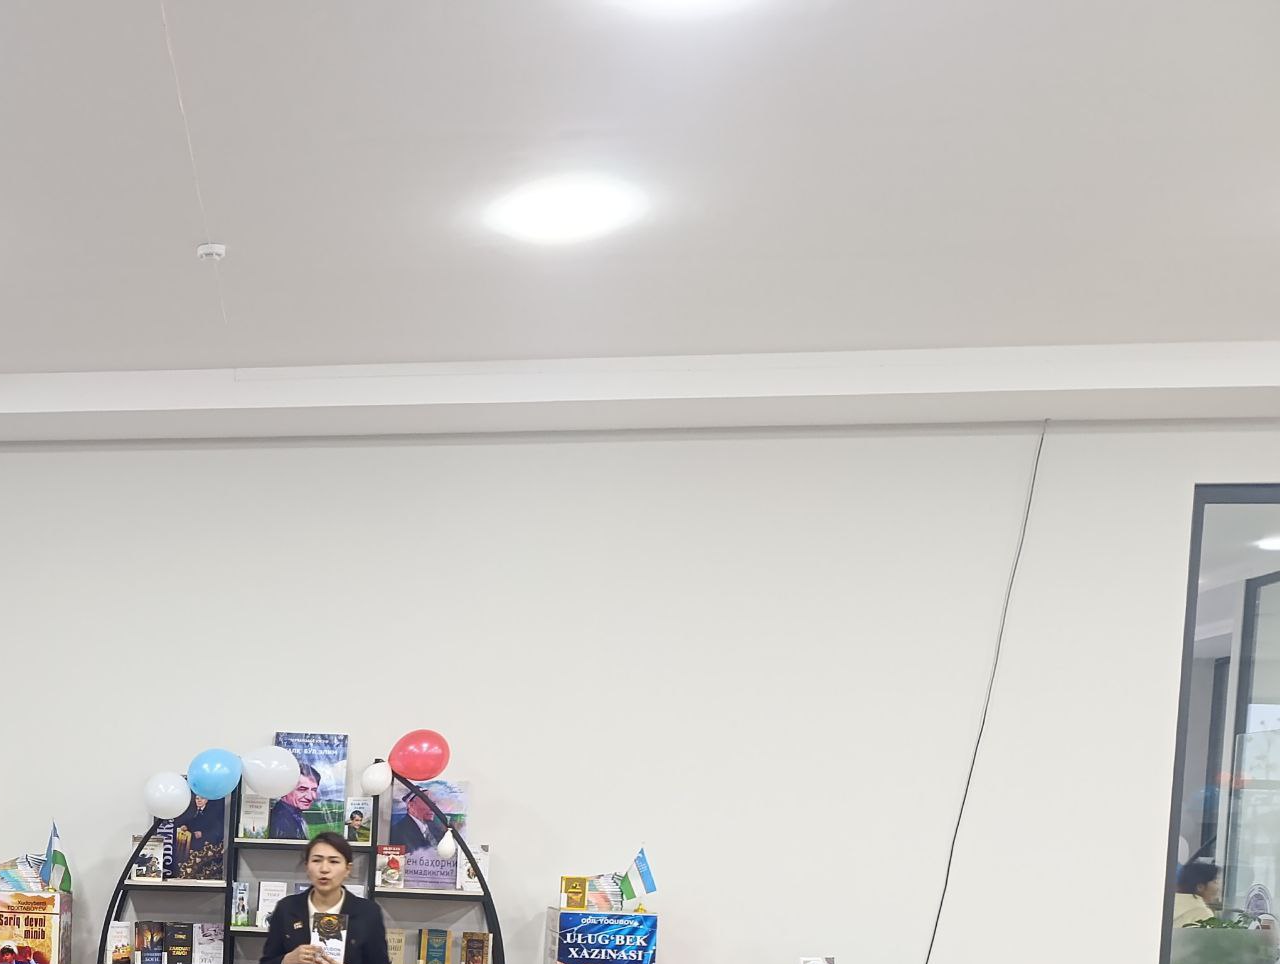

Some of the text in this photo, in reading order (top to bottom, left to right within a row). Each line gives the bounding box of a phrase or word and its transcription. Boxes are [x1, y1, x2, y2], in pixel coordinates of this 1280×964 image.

[405, 858, 417, 866] ен
[405, 869, 454, 877] инмадингми?
[24, 915, 46, 927] devni
[24, 928, 46, 940] minib
[568, 947, 643, 961] XAZINASI
